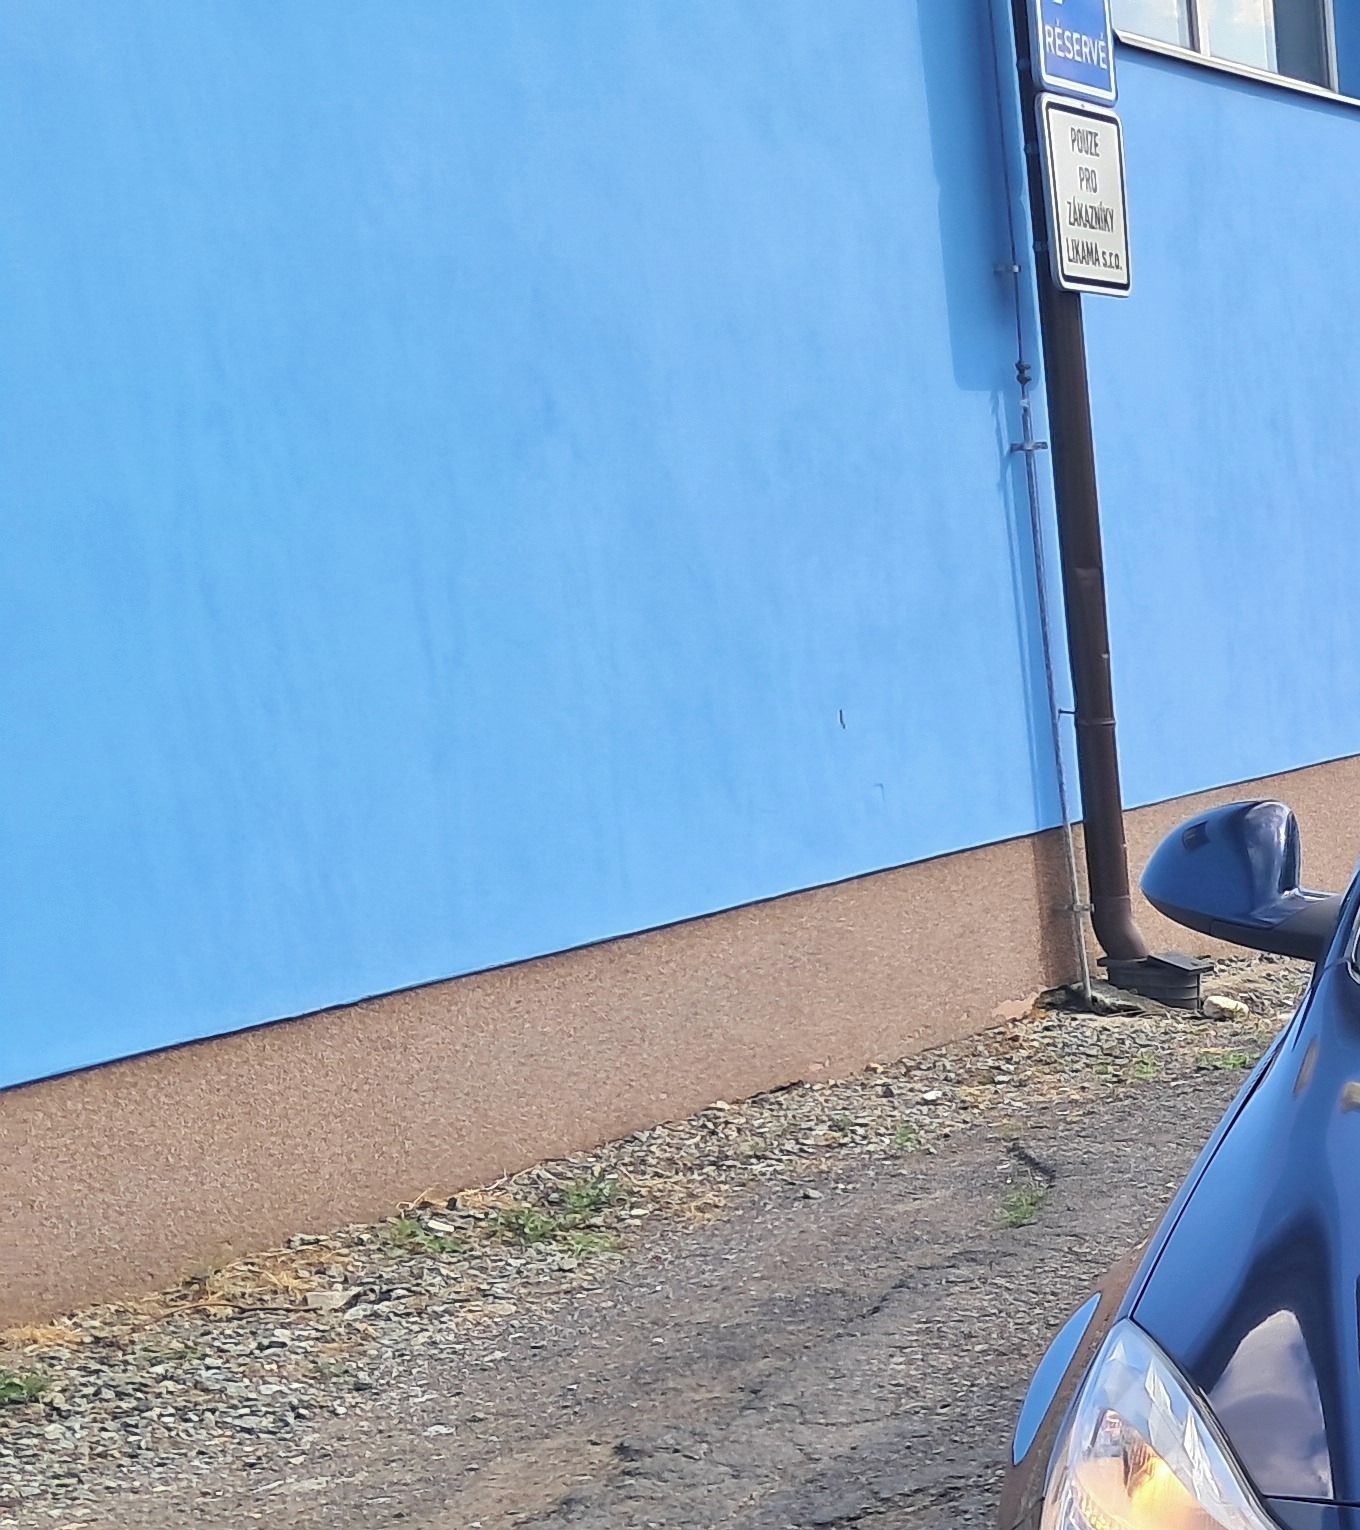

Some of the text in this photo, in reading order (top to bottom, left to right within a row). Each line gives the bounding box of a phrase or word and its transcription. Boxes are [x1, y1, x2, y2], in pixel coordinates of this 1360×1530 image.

[1045, 17, 1107, 69] RÉSERVÉ
[1070, 127, 1100, 158] POUZE
[1078, 166, 1097, 194] PRO
[1066, 195, 1114, 233] ZÁKAZNÍKY
[1065, 237, 1123, 271] LIKAMA s.r.o.
